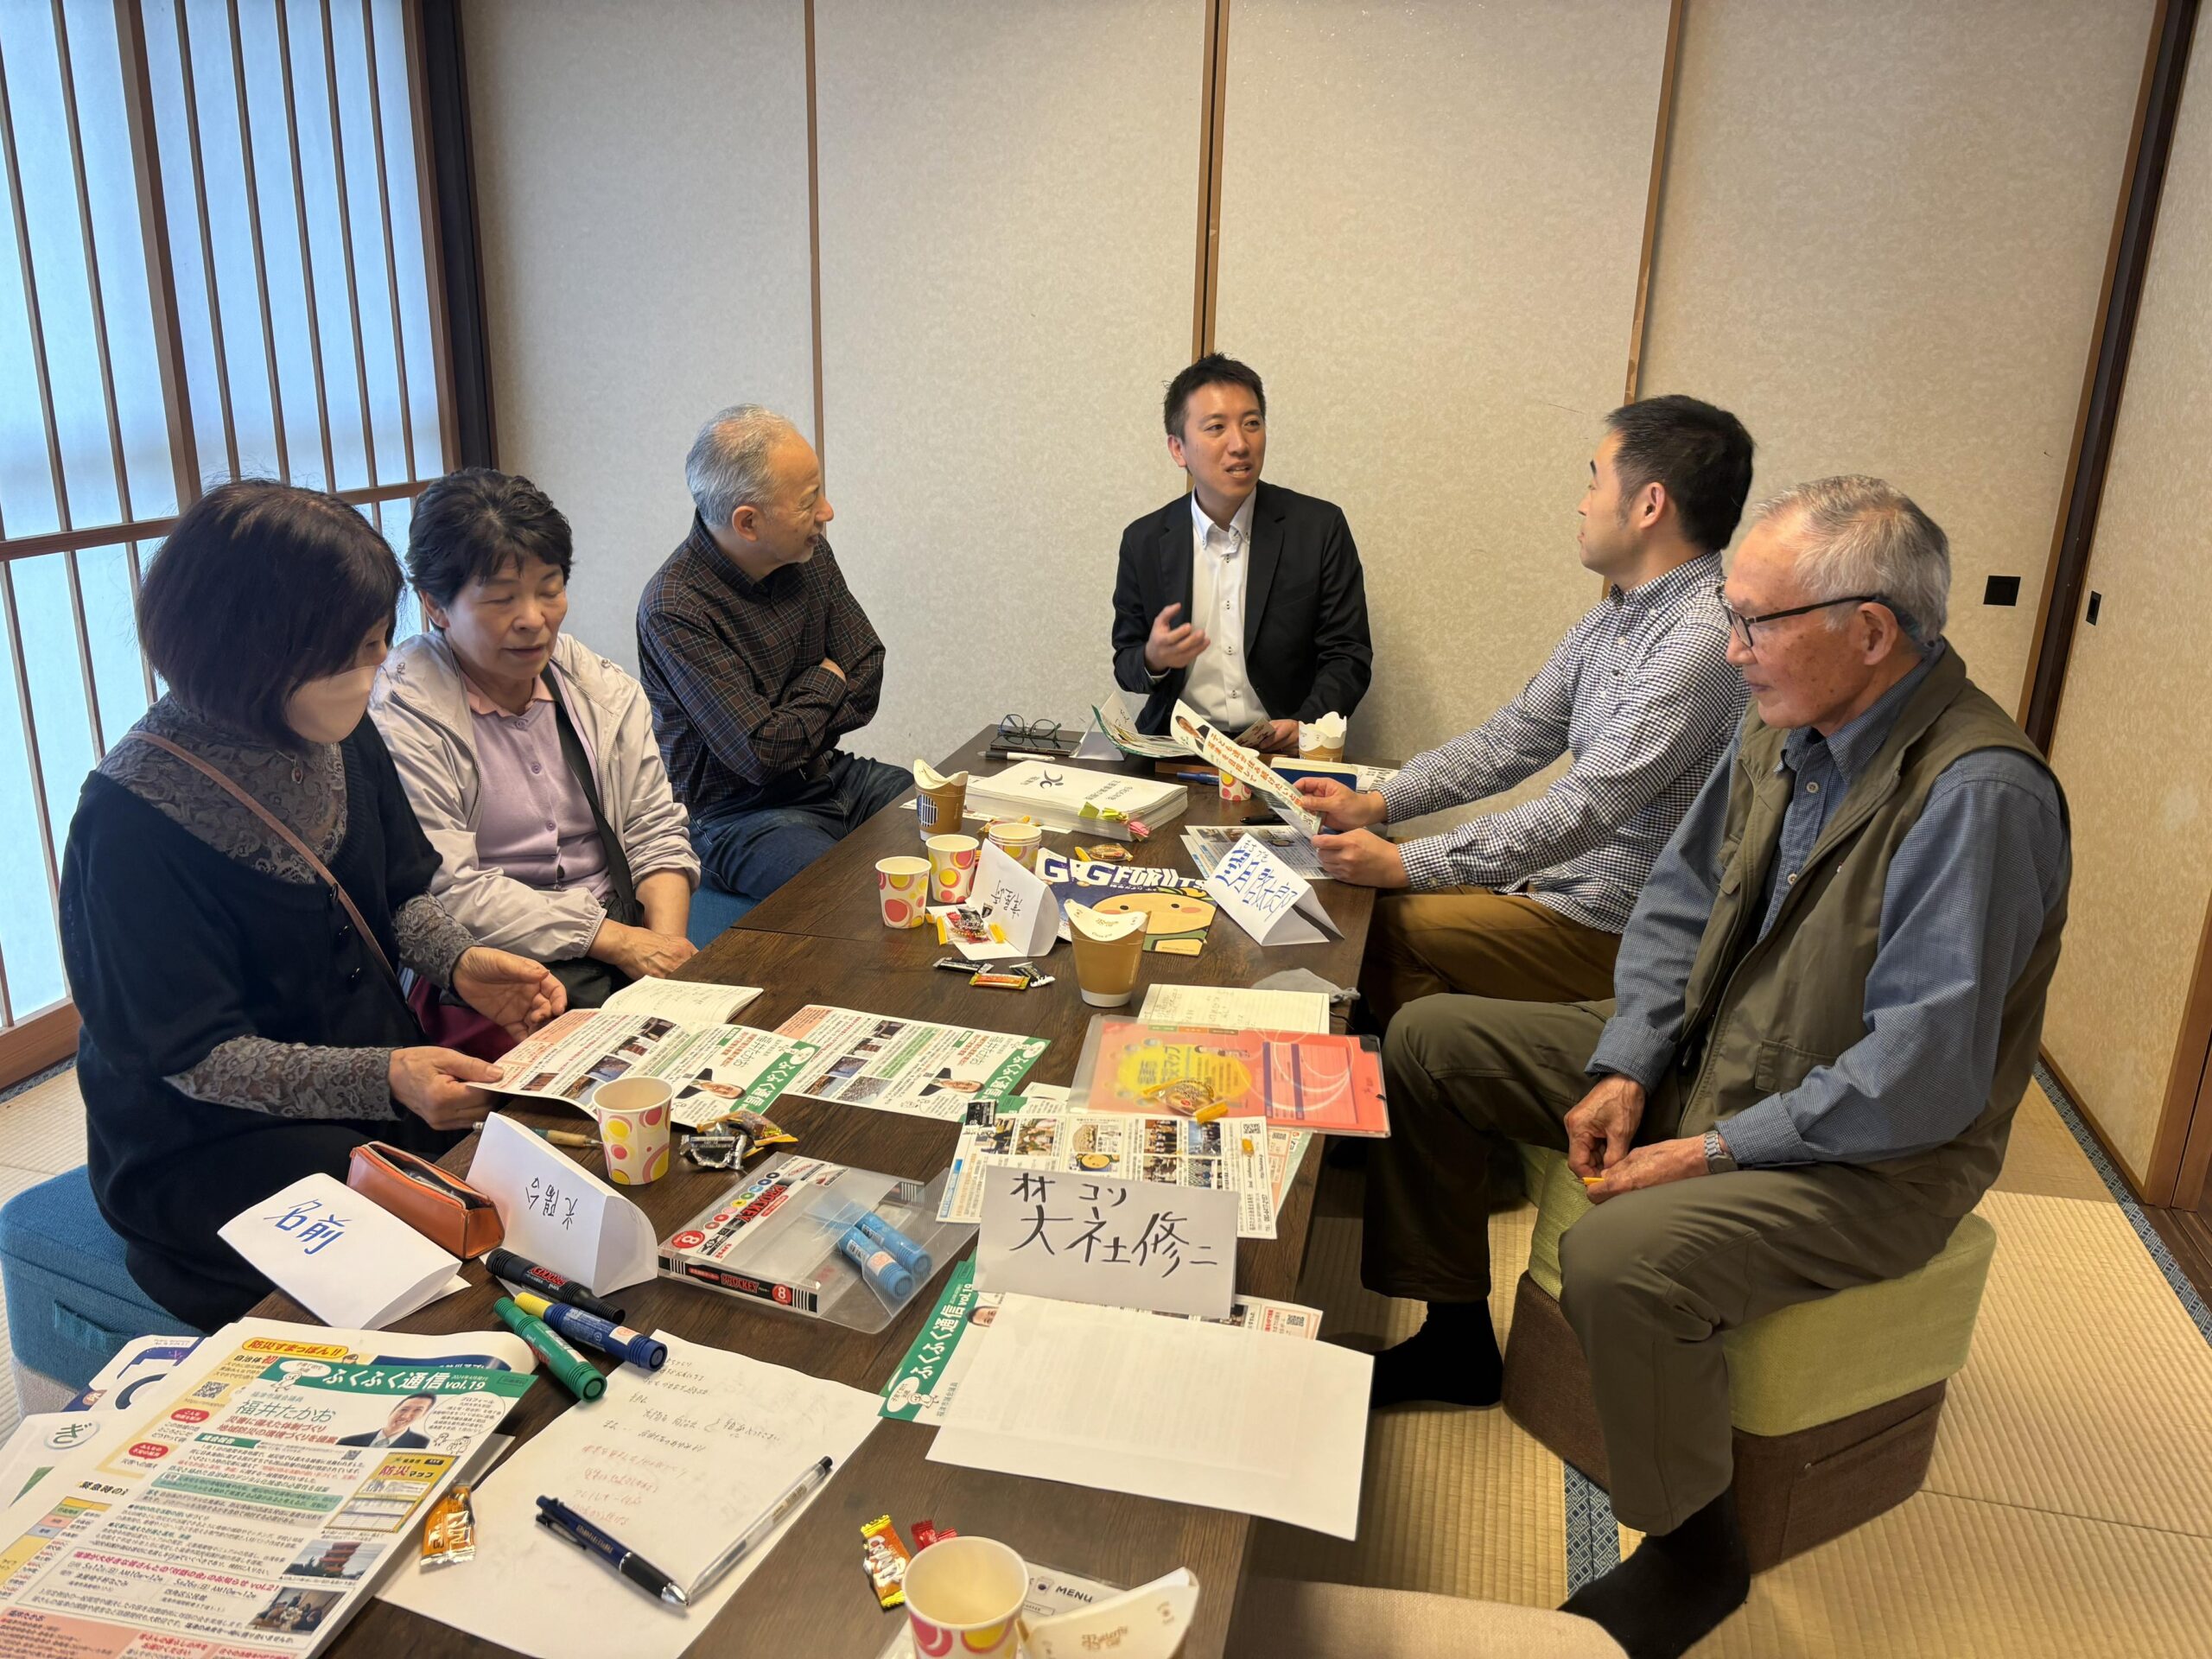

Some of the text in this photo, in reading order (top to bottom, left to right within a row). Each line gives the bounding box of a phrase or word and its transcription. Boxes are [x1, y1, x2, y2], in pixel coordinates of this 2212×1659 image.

[735, 1184, 789, 1223] PROCKEY
[264, 1198, 352, 1255] 名前
[1009, 1205, 1218, 1278] 大社修二
[721, 1274, 760, 1294] PROCKEY
[910, 1304, 963, 1382] ふくふく通信
[322, 1369, 451, 1389] ふくふく通信
[445, 1381, 486, 1390] vol.19
[236, 1400, 336, 1422] 福井たかお
[1055, 1586, 1093, 1604] MENU
